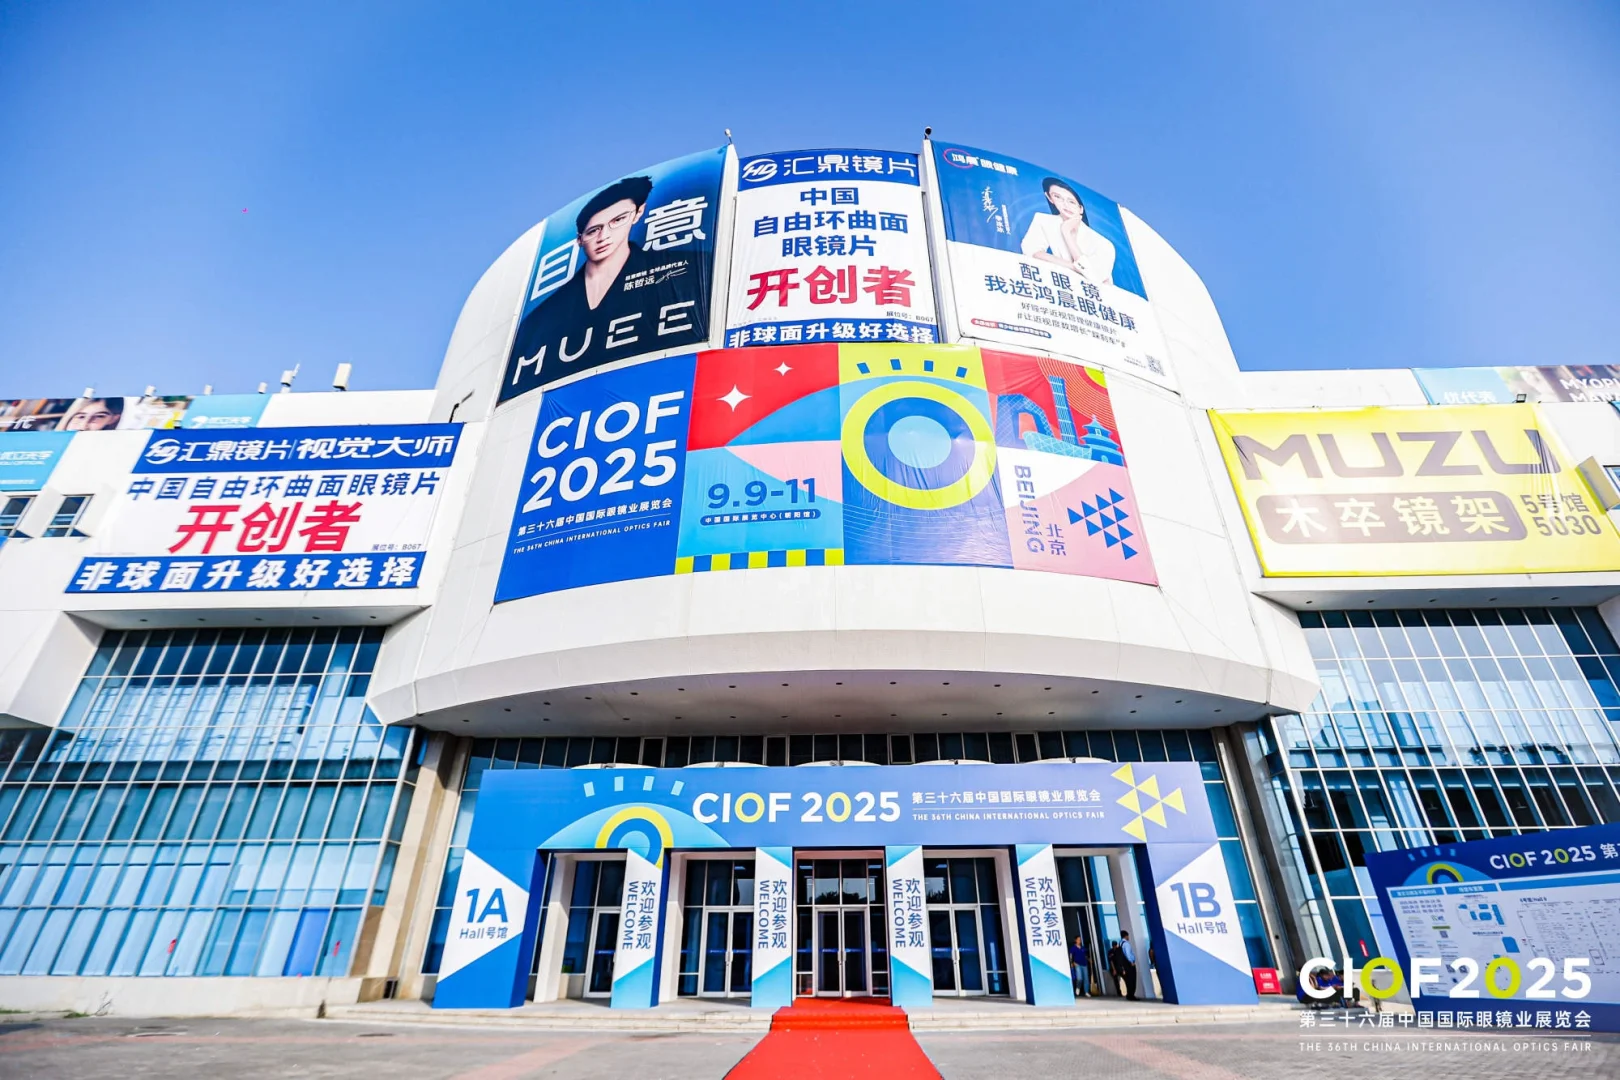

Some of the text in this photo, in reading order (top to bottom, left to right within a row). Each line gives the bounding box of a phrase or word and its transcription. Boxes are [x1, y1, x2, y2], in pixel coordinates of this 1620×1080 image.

[783, 154, 917, 178] 汇鼎镜片
[800, 187, 859, 206] 中国
[753, 211, 908, 237] 自由环曲面
[782, 234, 877, 257] 眼镜片
[747, 265, 916, 311] 开创者
[1019, 262, 1102, 302] 配眼镜
[984, 275, 1138, 333] 我选鸿晨眼健康
[512, 300, 696, 385] MUEE
[729, 322, 934, 347] 非球面升级好选择
[537, 390, 685, 459] CIOF
[177, 438, 292, 462] 汇鼎镜片
[298, 435, 454, 460] 视觉大师
[1232, 430, 1561, 480] MUZU
[127, 472, 441, 500] 中国自由环曲面眼镜片
[521, 440, 677, 514] 2025
[708, 478, 815, 509] 9.9-11
[517, 498, 673, 536] 第三十六届中国国际眼镜业展览会
[1014, 465, 1044, 553] BEIJING
[1276, 495, 1510, 538] 木卒镜架
[1521, 492, 1589, 513] 5号馆
[168, 500, 363, 554] 开创者
[544, 538, 564, 547] CHINA
[566, 528, 621, 542] INTERNATIONAL
[624, 523, 650, 532] OPTICS
[653, 520, 671, 528] FAIR
[1047, 524, 1066, 556] 北京
[1533, 514, 1602, 536] 5030
[75, 557, 417, 590] 非球面升级好选择
[692, 791, 902, 823] CIOF 2025
[912, 789, 1101, 804] 第三十六届中国国际眼镜业展览会
[912, 813, 928, 821] THE
[954, 813, 980, 821] CHINA
[983, 812, 1049, 820] INTERNATIONAL
[1052, 811, 1083, 819] OPTICS
[1086, 811, 1104, 819] FAIR
[1490, 851, 1537, 869] CIOF
[1540, 845, 1596, 865] 2025
[466, 888, 508, 924] 1A
[621, 880, 637, 950] WELCOME
[636, 880, 656, 950] 欢迎参观
[758, 880, 769, 950] WELCOME
[771, 880, 788, 949] 欢迎参观
[892, 879, 906, 948] WELCOME
[905, 878, 925, 947] 欢迎参观
[1024, 877, 1043, 947] WELCOME
[1038, 876, 1062, 947] 欢迎参观
[1171, 882, 1221, 919] 1B
